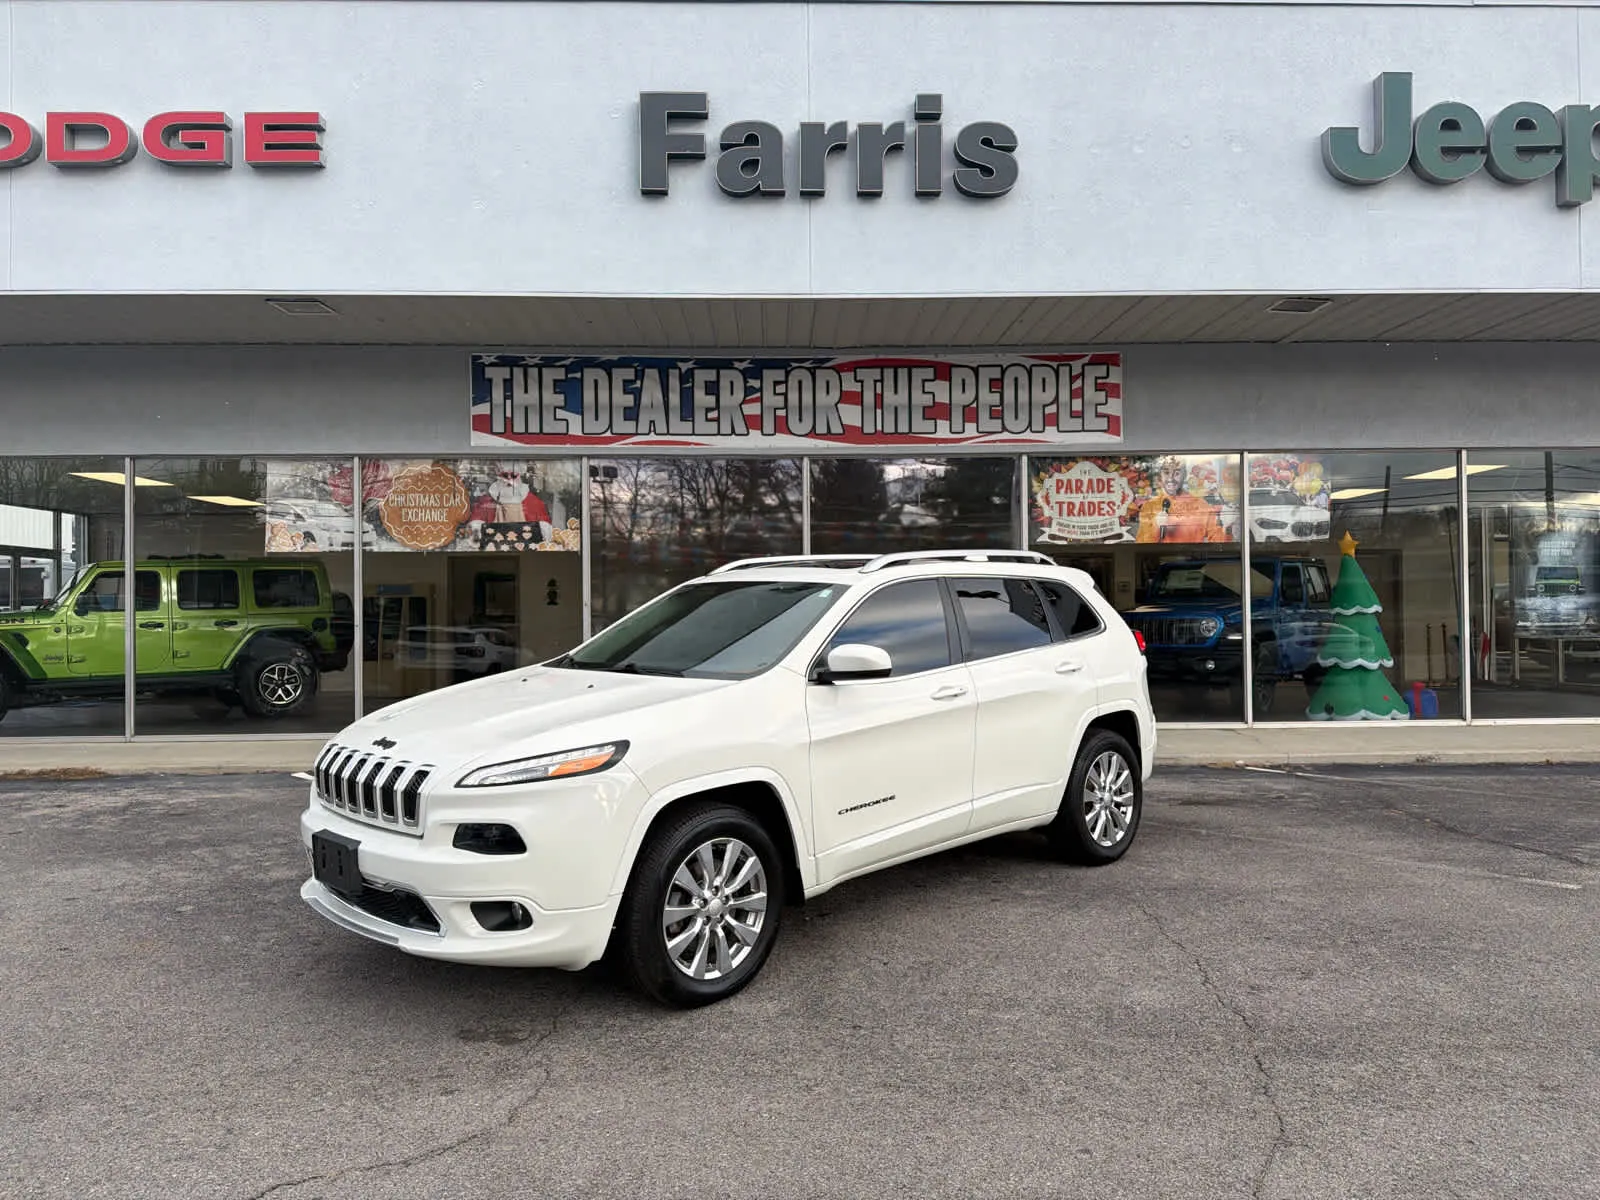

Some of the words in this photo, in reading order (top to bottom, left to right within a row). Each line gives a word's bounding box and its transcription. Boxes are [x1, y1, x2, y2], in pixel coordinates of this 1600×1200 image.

[639, 91, 1019, 200] Farris
[484, 366, 569, 435] THE
[582, 366, 750, 436] DEALER
[761, 366, 845, 436] FOR
[854, 364, 937, 435] THE
[950, 363, 1109, 434] PEOPLE
[1055, 478, 1115, 494] PARADE
[389, 493, 441, 507] CHRISTMAS
[443, 493, 461, 507] CAR
[402, 508, 449, 522] EXCHANGE
[1055, 501, 1117, 517] TRADES
[837, 794, 896, 816] CHEROKEE
